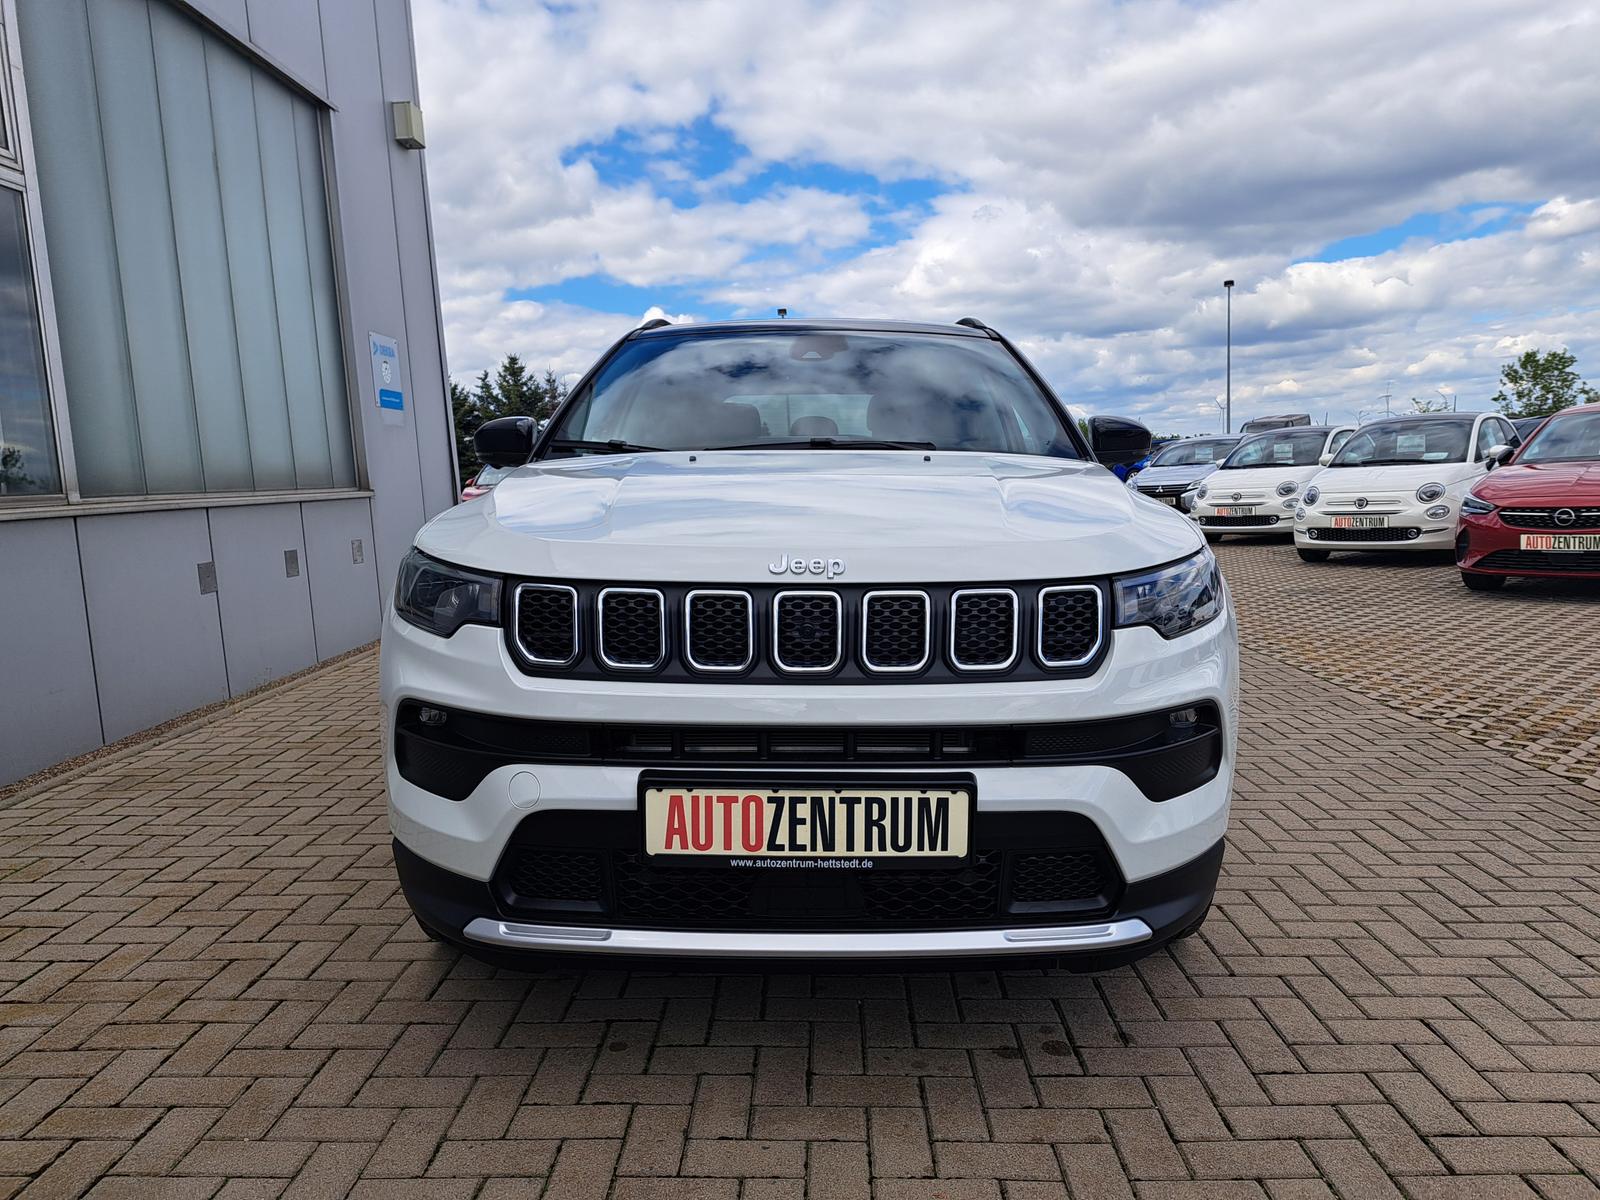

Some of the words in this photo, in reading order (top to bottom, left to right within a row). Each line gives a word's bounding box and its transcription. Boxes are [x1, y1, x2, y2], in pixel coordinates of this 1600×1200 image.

[1334, 516, 1385, 528] AUTOZENTRUM
[1525, 535, 1600, 550] AUTOZENTRUM
[768, 553, 846, 579] Jeep
[664, 795, 950, 852] AUTOZENTRUM
[730, 858, 873, 869] www.autozentrum-hettstedt.de
